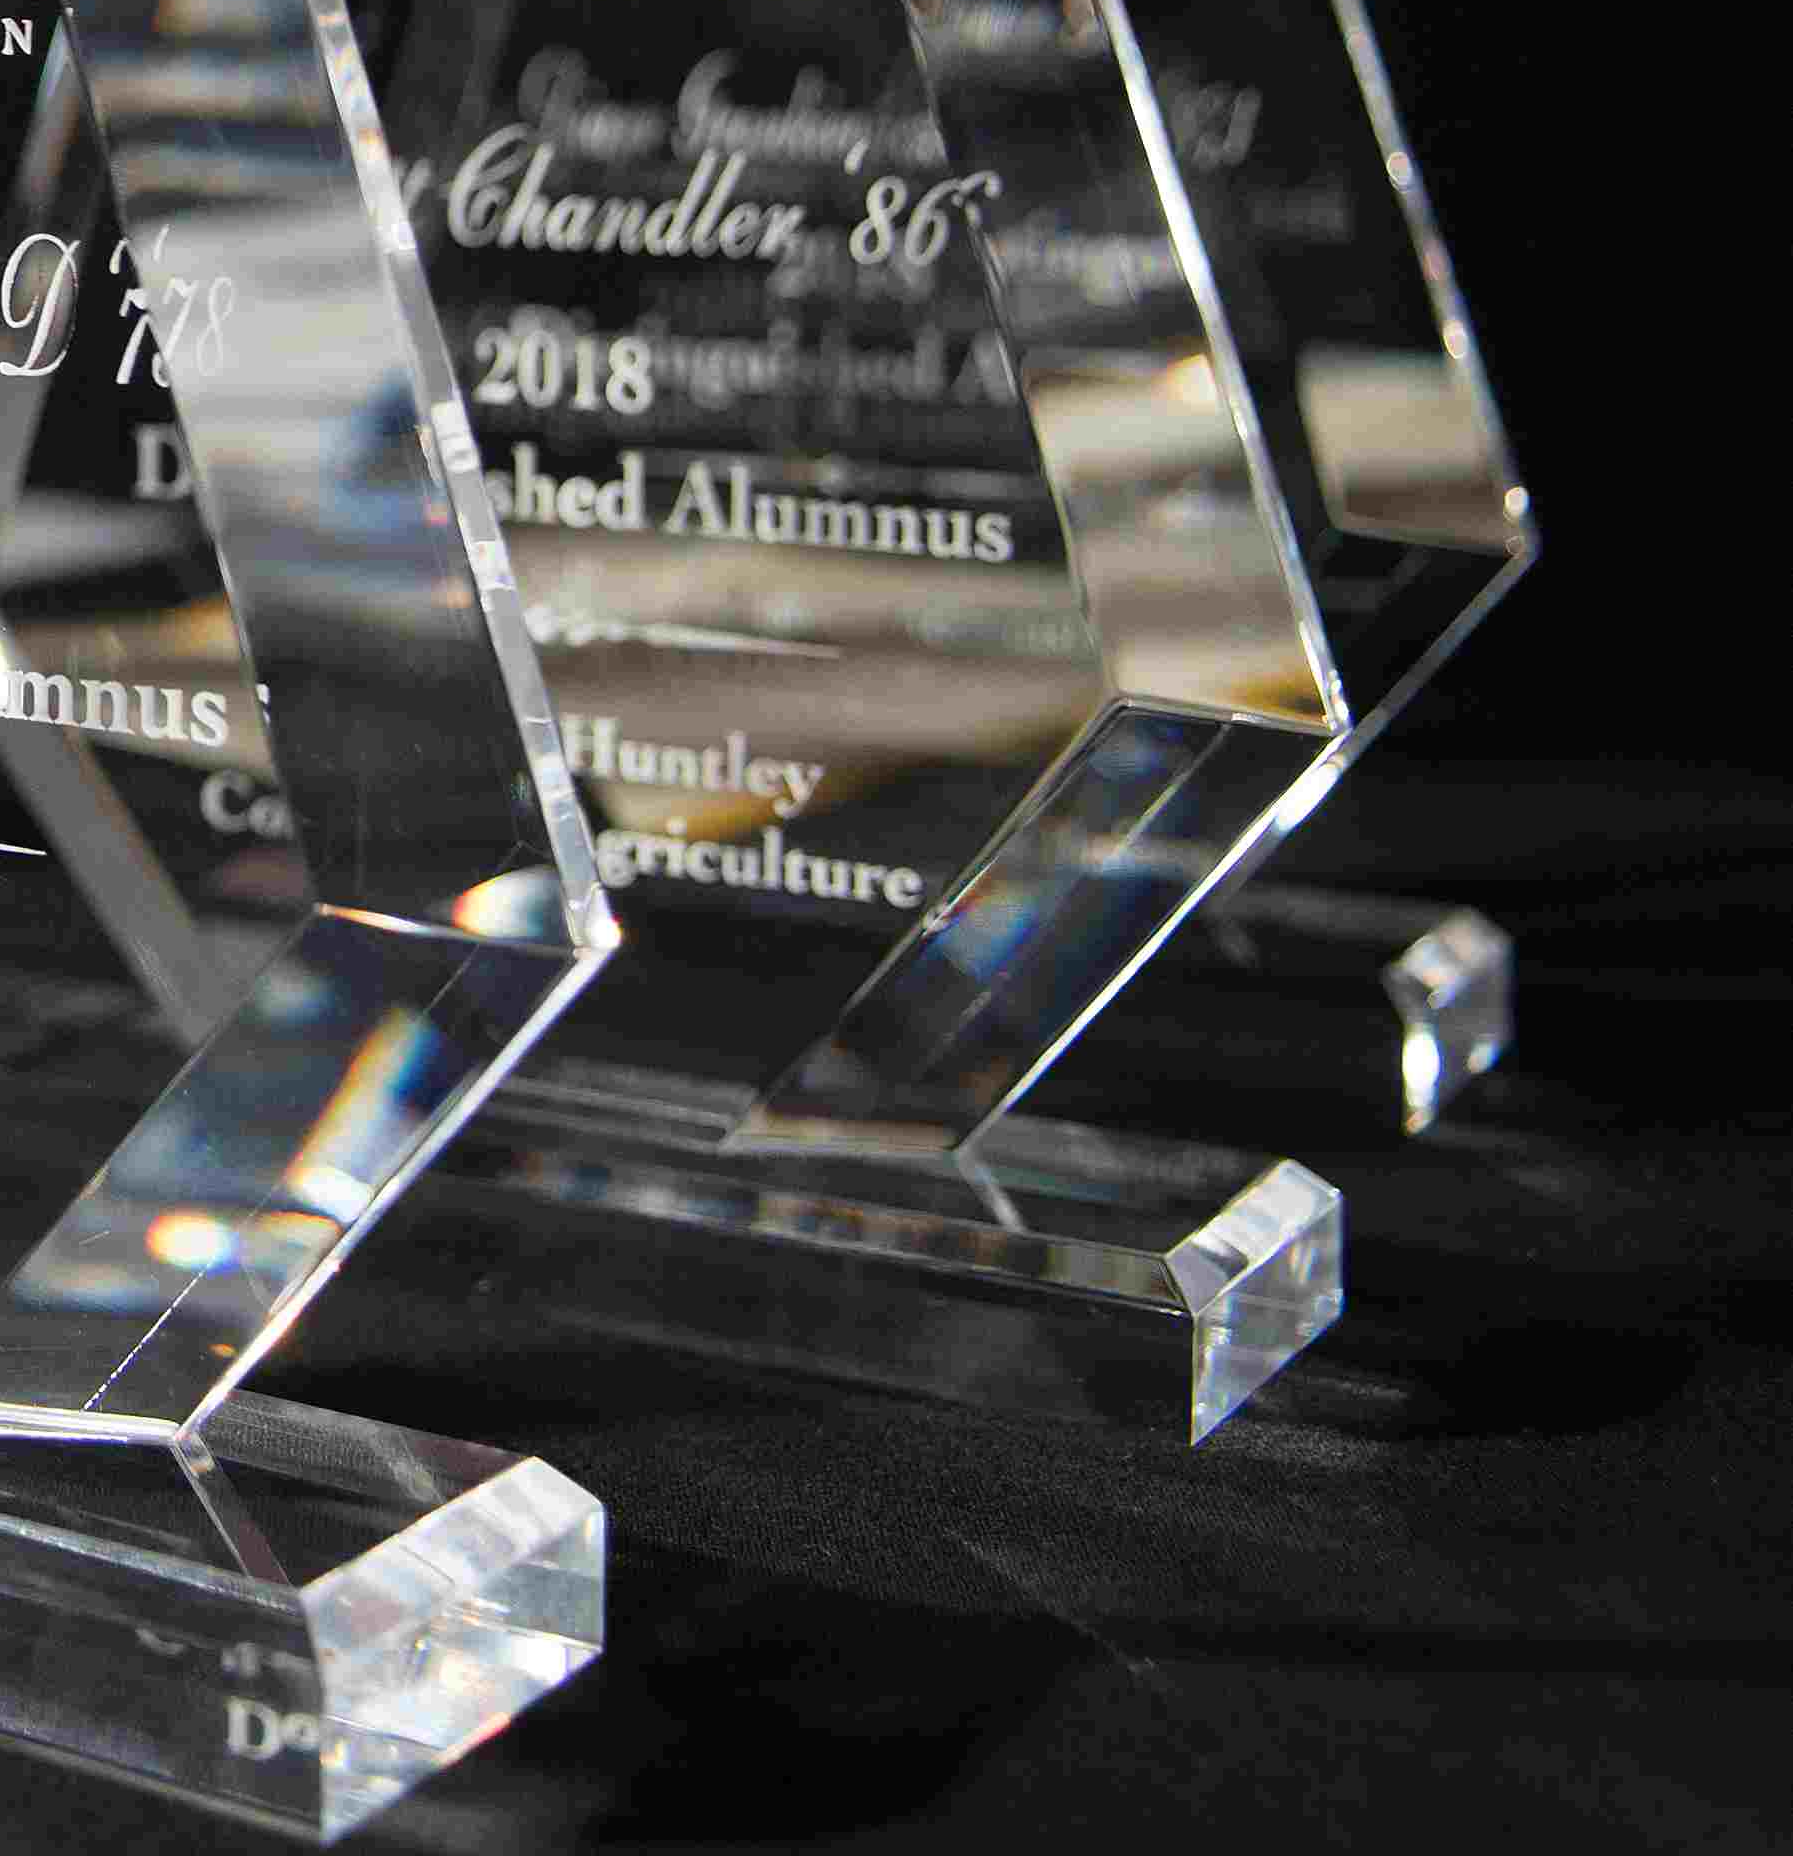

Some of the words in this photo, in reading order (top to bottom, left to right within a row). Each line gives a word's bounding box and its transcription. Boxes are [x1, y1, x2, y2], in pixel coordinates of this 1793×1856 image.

[474, 327, 654, 415] 2018
[664, 460, 1013, 562] Alumnus
[561, 714, 823, 819] Huntley
[596, 822, 925, 909] griculture
